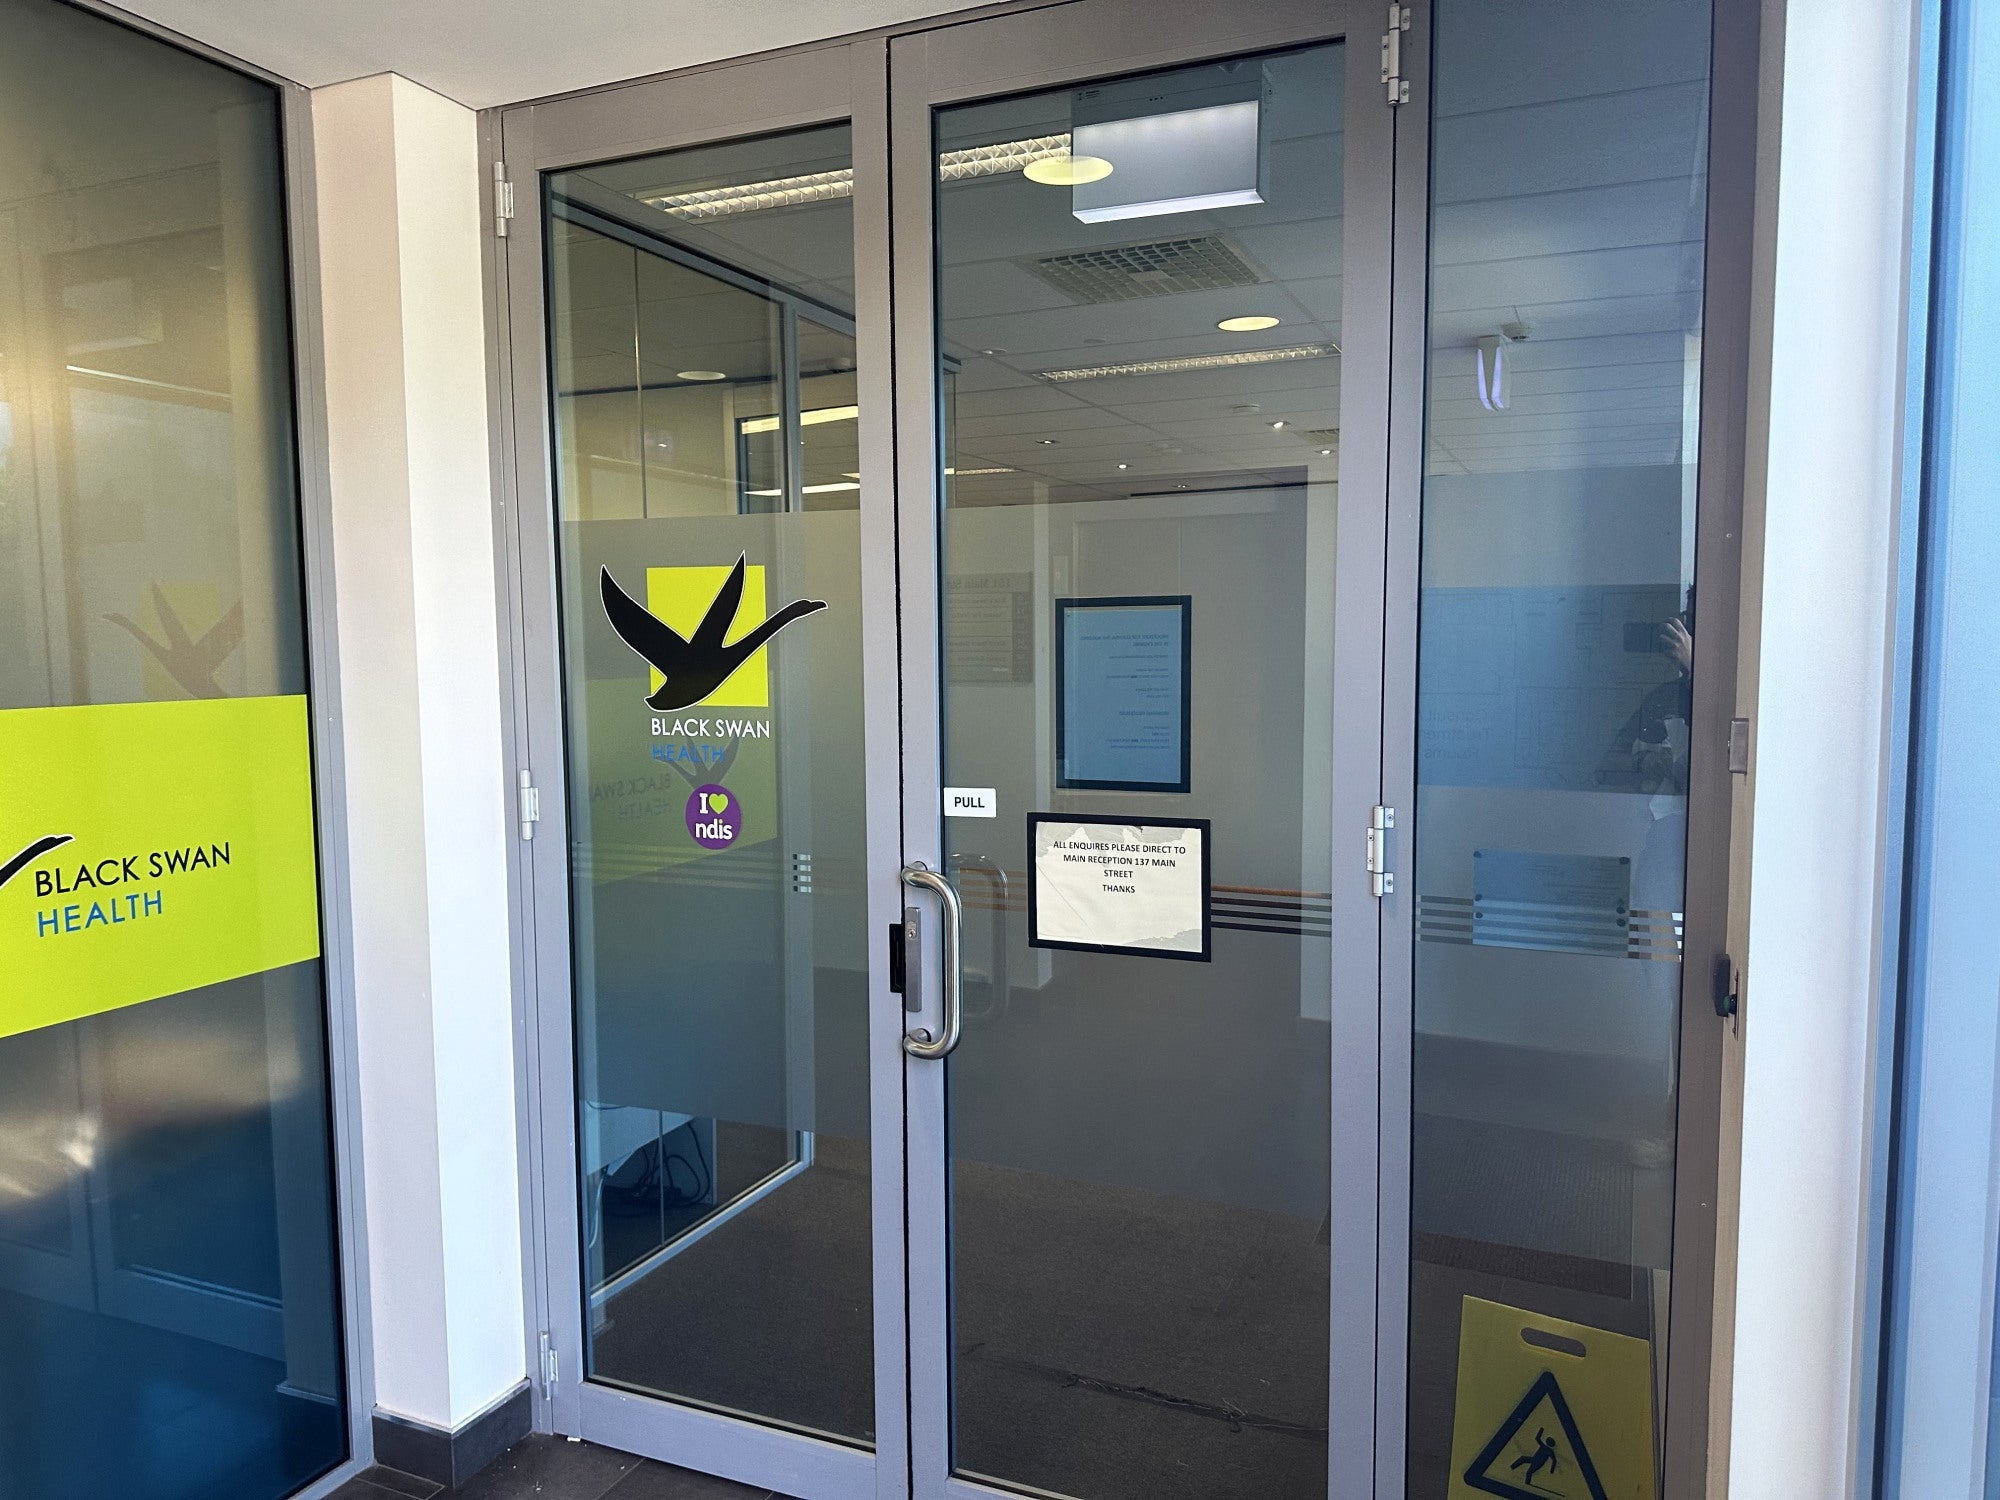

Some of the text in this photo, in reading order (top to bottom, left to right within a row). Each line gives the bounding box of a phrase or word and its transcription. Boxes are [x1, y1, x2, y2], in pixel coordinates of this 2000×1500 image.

[651, 718, 770, 739] BLACK SWAN
[651, 743, 725, 763] HEALTH
[699, 793, 709, 814] I
[954, 796, 985, 808] PULL
[695, 819, 733, 840] ndis
[1053, 841, 1186, 854] ALL ENQUIRES PLEASE DIRECT TO
[35, 841, 230, 898] BLACK SWAN
[1063, 854, 1176, 867] MAIN RECEPTION 137 MAIN
[1103, 869, 1133, 878] STREET
[1102, 884, 1136, 894] THANKS
[37, 889, 163, 938] HEALTH
